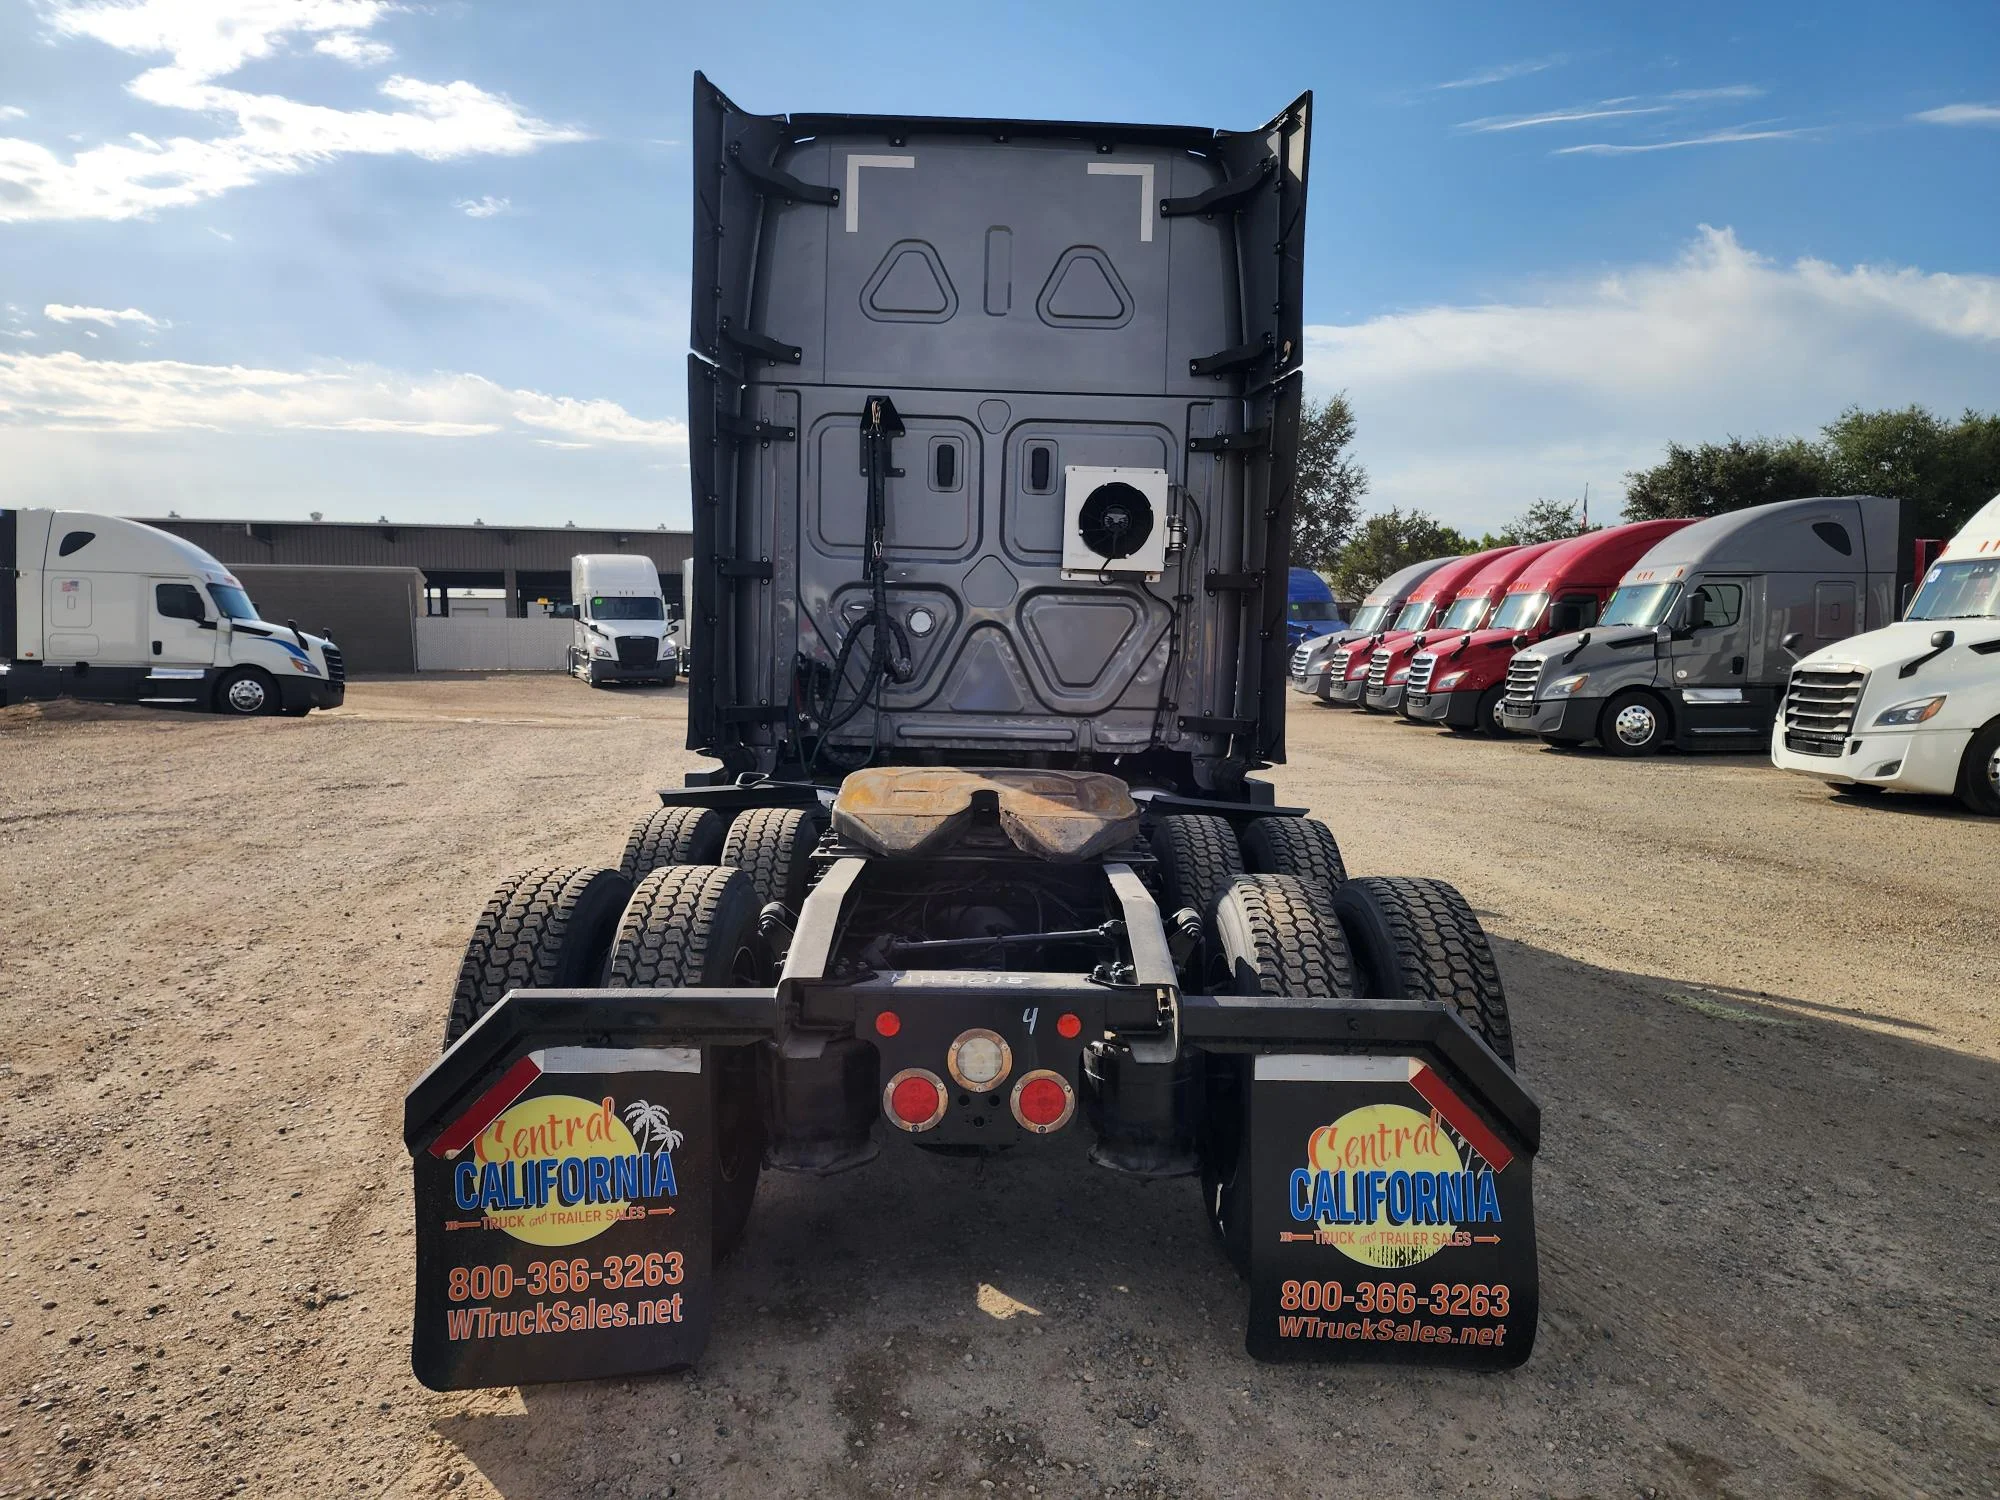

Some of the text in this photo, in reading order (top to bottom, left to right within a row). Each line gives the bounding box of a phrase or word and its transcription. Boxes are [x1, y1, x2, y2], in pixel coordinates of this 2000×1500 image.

[1022, 1007, 1039, 1035] 4
[474, 1096, 617, 1166] Central
[1308, 1108, 1441, 1174] Central
[454, 1151, 678, 1211] CALIFORNIA
[1289, 1168, 1502, 1224] CALIFORNIA
[481, 1205, 646, 1230] TRUCK and TRAILER SALES
[1313, 1230, 1355, 1245] TRUCK
[1380, 1231, 1428, 1246] TRAILER
[1432, 1231, 1472, 1247] SALES
[448, 1251, 684, 1302] 800-366-3263
[1280, 1280, 1510, 1317] 800-366-3263
[447, 1292, 684, 1341] WTruckSales.net
[1278, 1315, 1506, 1347] WTruckSales.net
